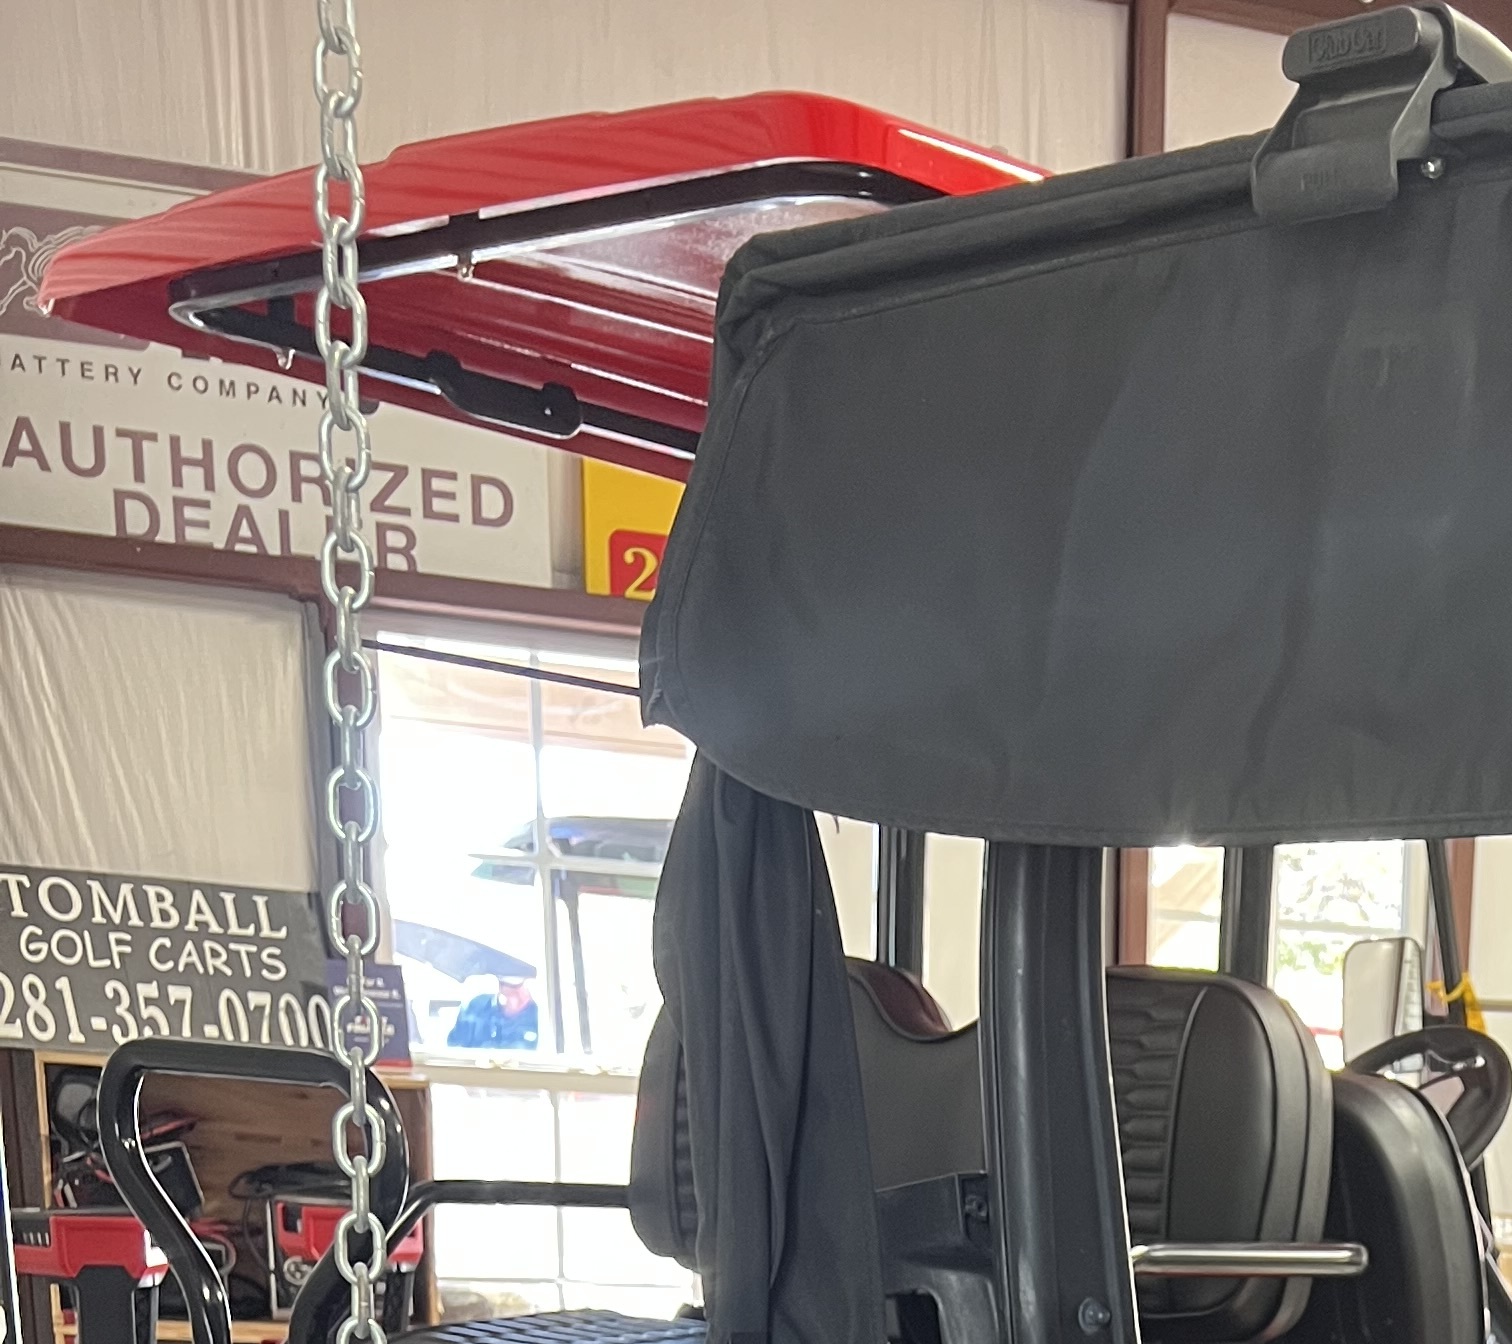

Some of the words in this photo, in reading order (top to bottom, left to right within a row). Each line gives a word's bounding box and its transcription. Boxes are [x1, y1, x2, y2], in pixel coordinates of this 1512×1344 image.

[0, 350, 144, 386] ATTERY
[166, 371, 329, 409] COMPANY
[1, 415, 515, 529] AUTHORZED
[112, 489, 419, 573] DEALR
[0, 872, 288, 940] TOMBALL
[19, 924, 133, 970] GOLF
[148, 936, 288, 982] CARTS
[0, 972, 334, 1053] 281-357-0700
